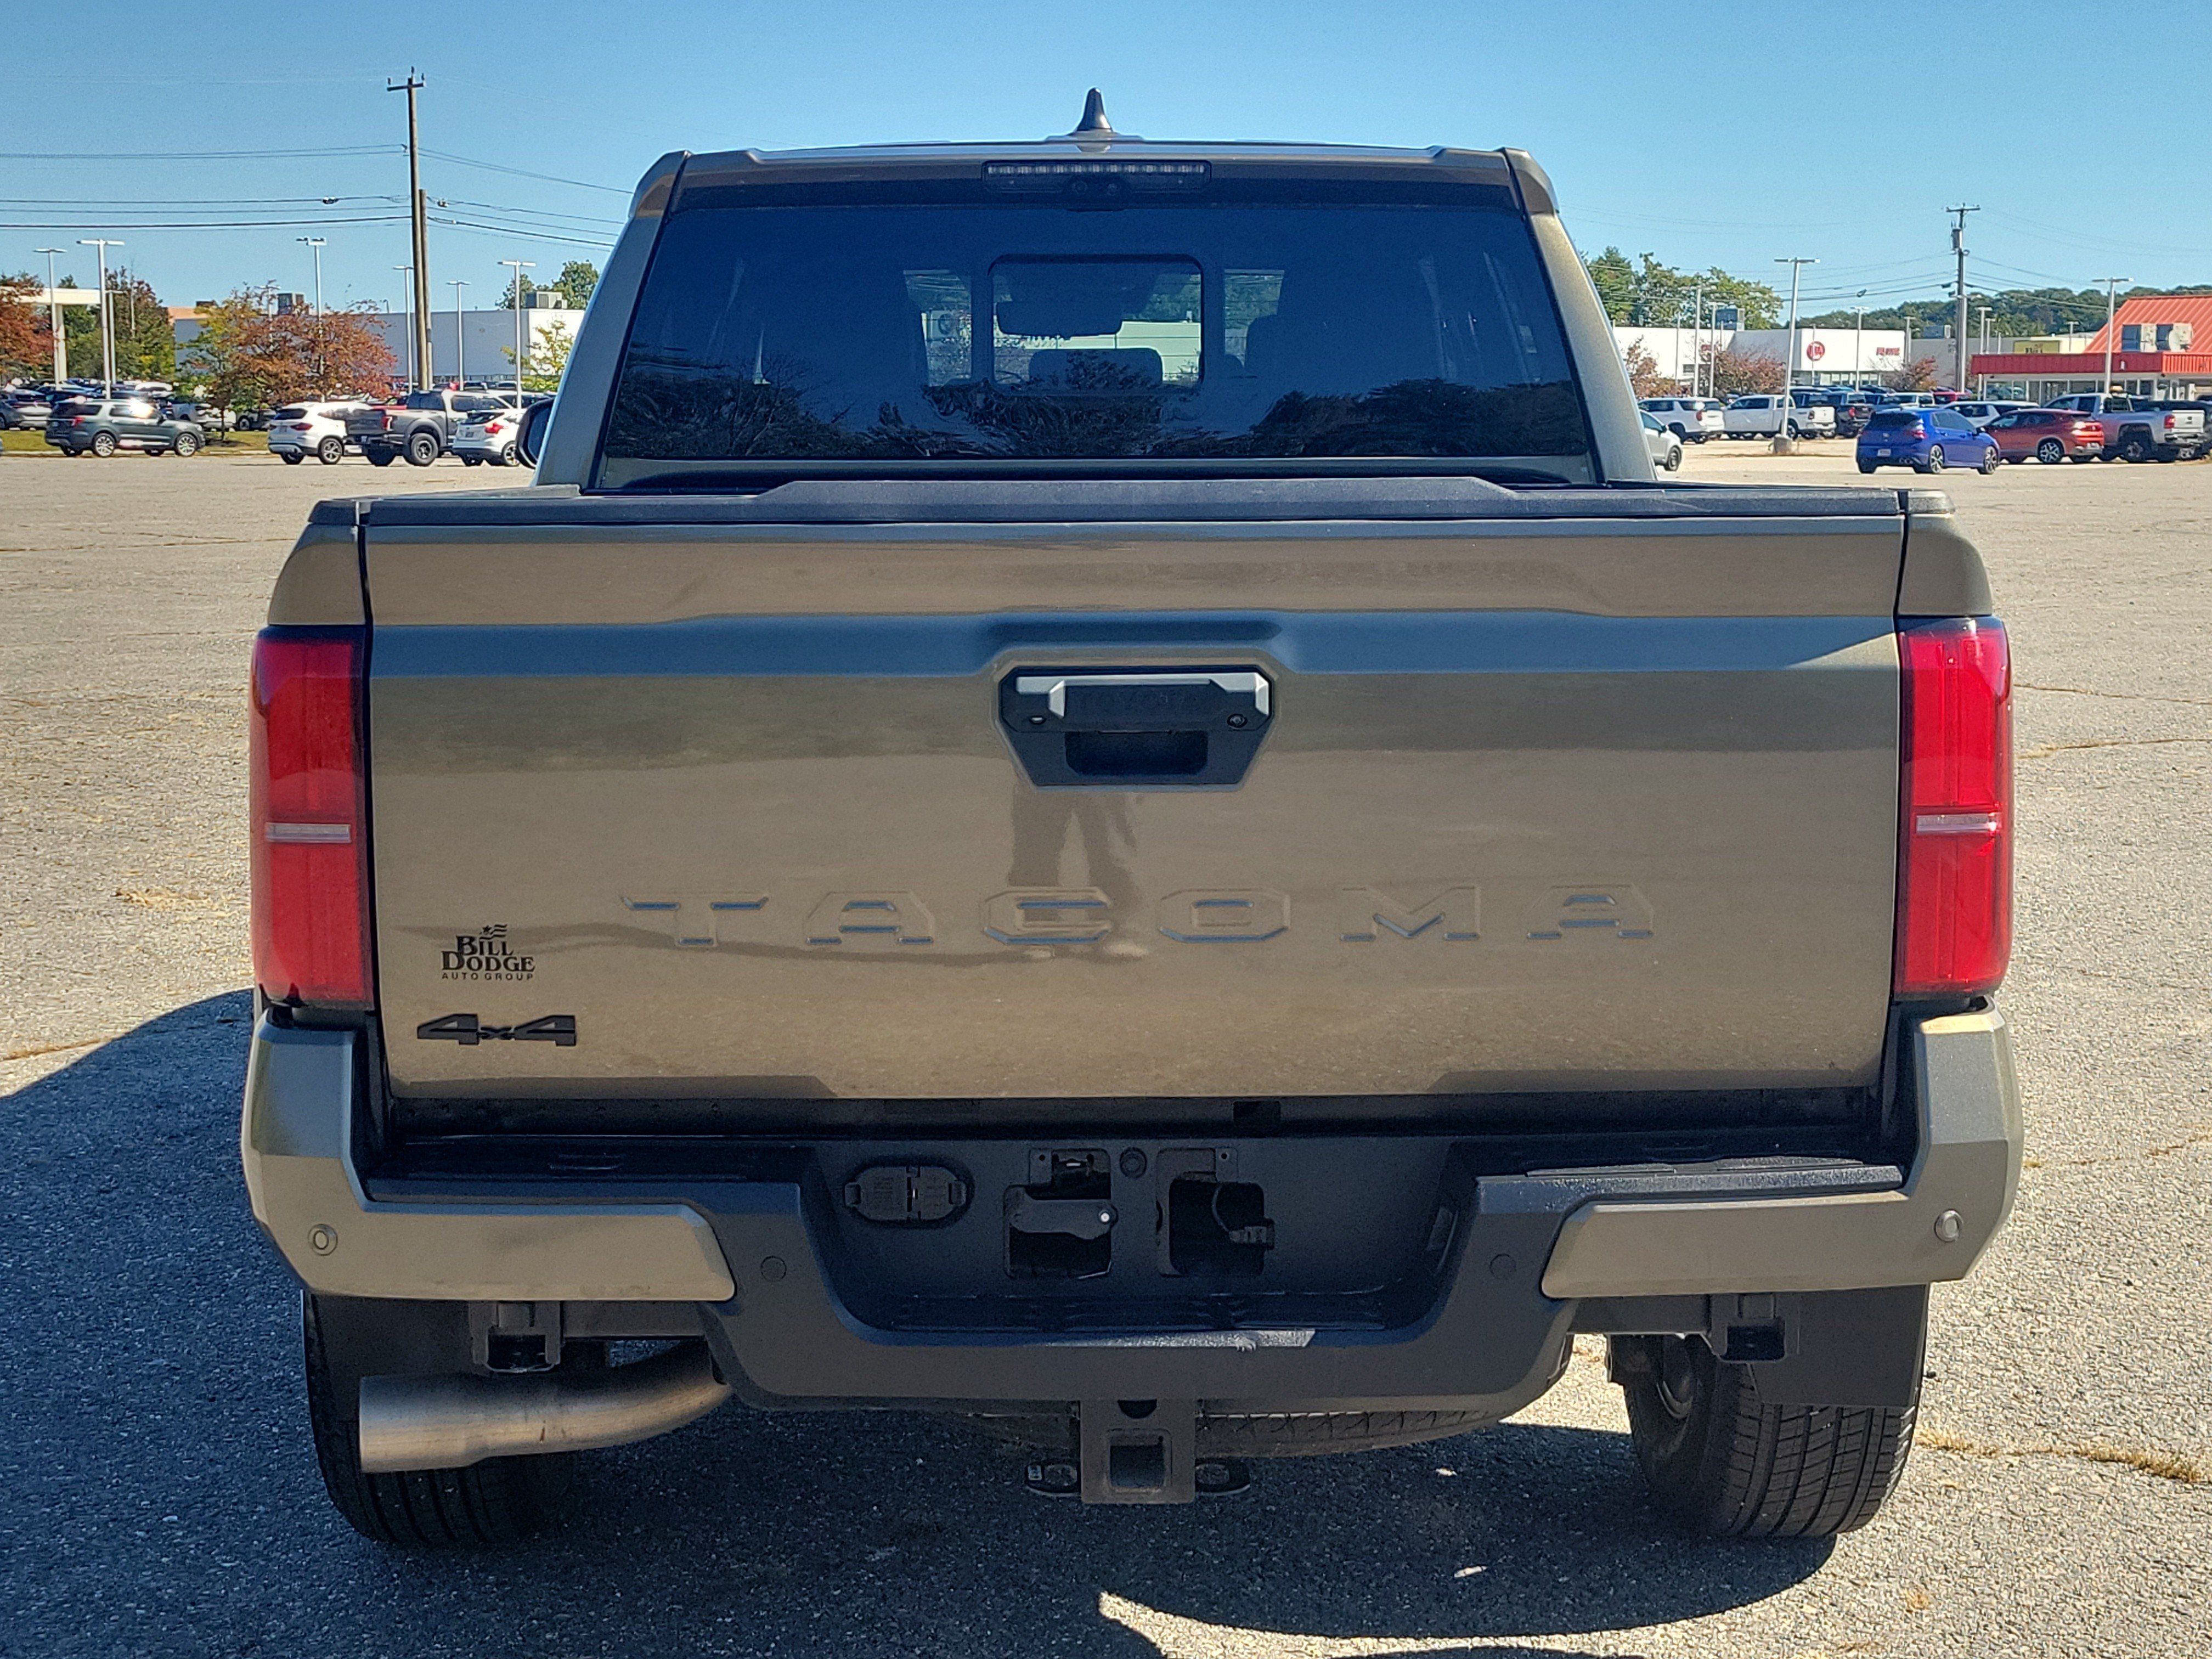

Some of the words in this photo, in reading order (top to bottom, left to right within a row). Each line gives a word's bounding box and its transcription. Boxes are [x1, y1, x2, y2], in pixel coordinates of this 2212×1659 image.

[620, 883, 1654, 947] TACOMA
[455, 935, 514, 956] BILL
[441, 950, 536, 972] DODGE
[441, 972, 479, 980] AUTO
[484, 972, 533, 981] GROUP
[417, 1013, 577, 1047] 4x4
